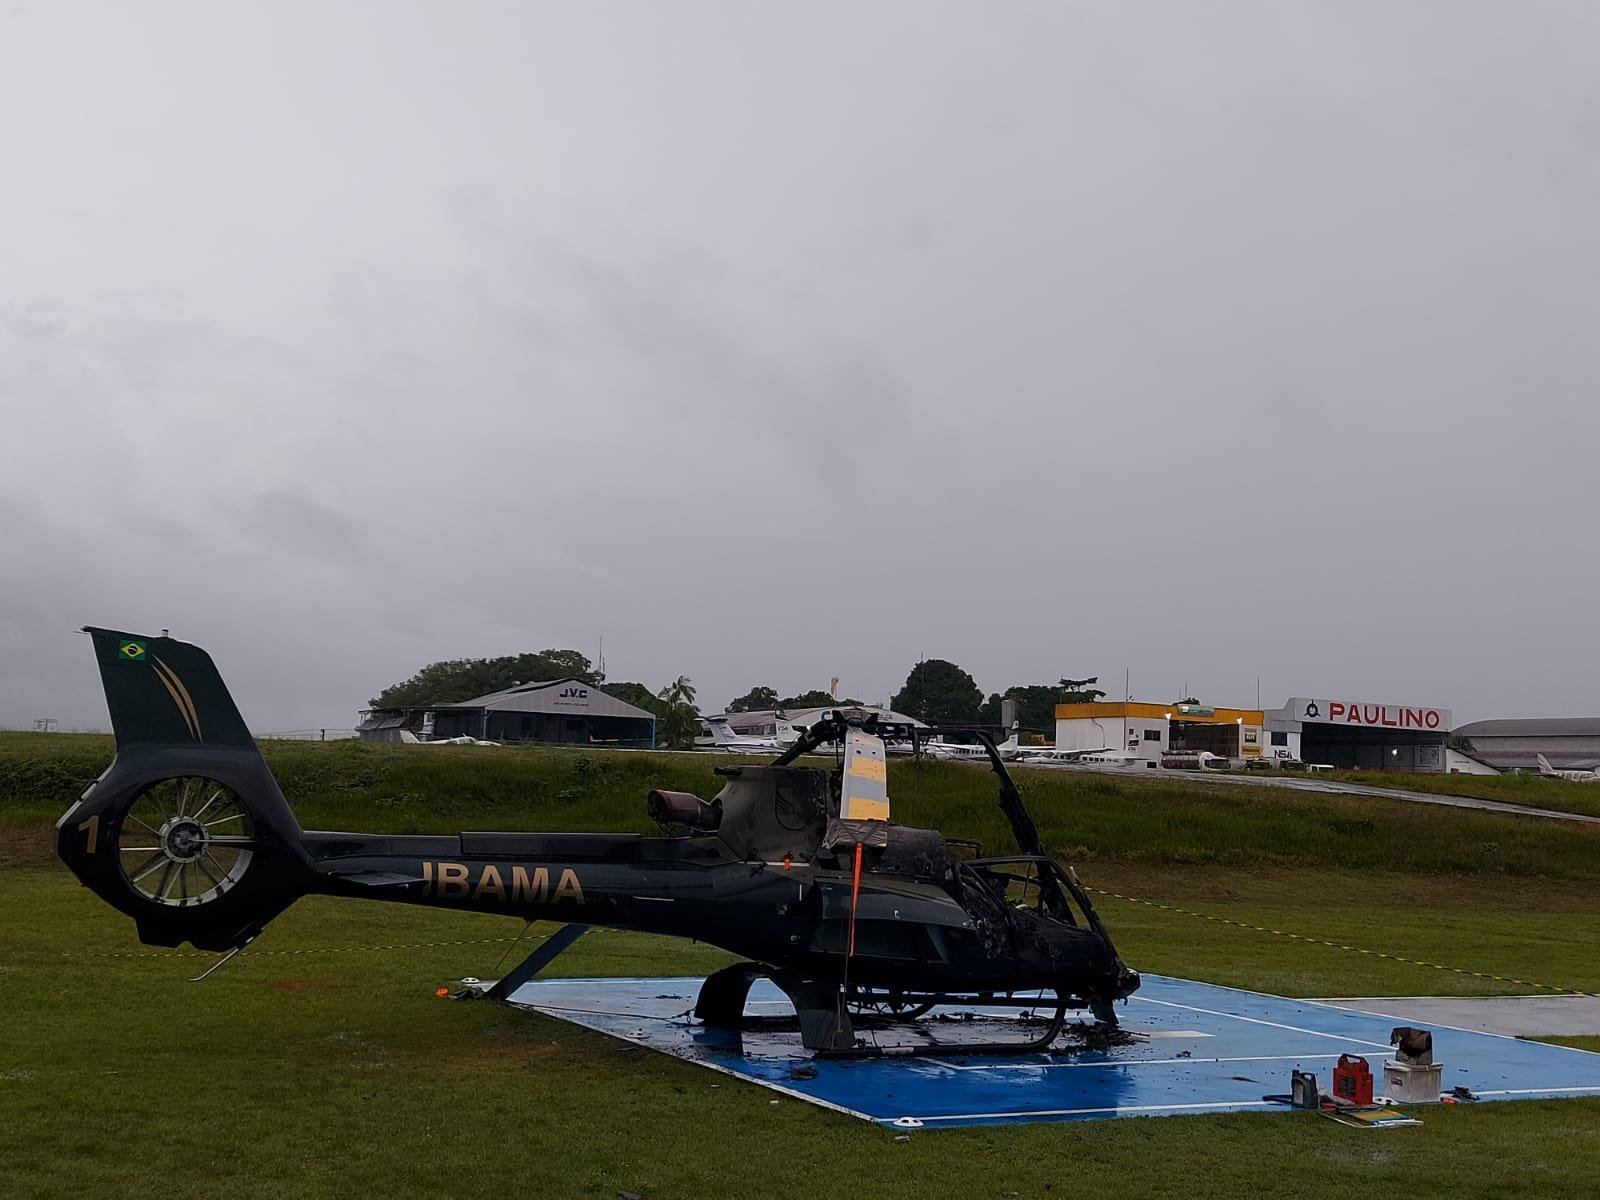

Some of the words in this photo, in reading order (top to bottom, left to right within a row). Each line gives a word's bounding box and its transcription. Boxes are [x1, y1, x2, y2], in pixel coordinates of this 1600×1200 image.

[1329, 702, 1440, 728] PAULINO
[78, 815, 100, 853] 1
[421, 861, 586, 905] IBAMA
